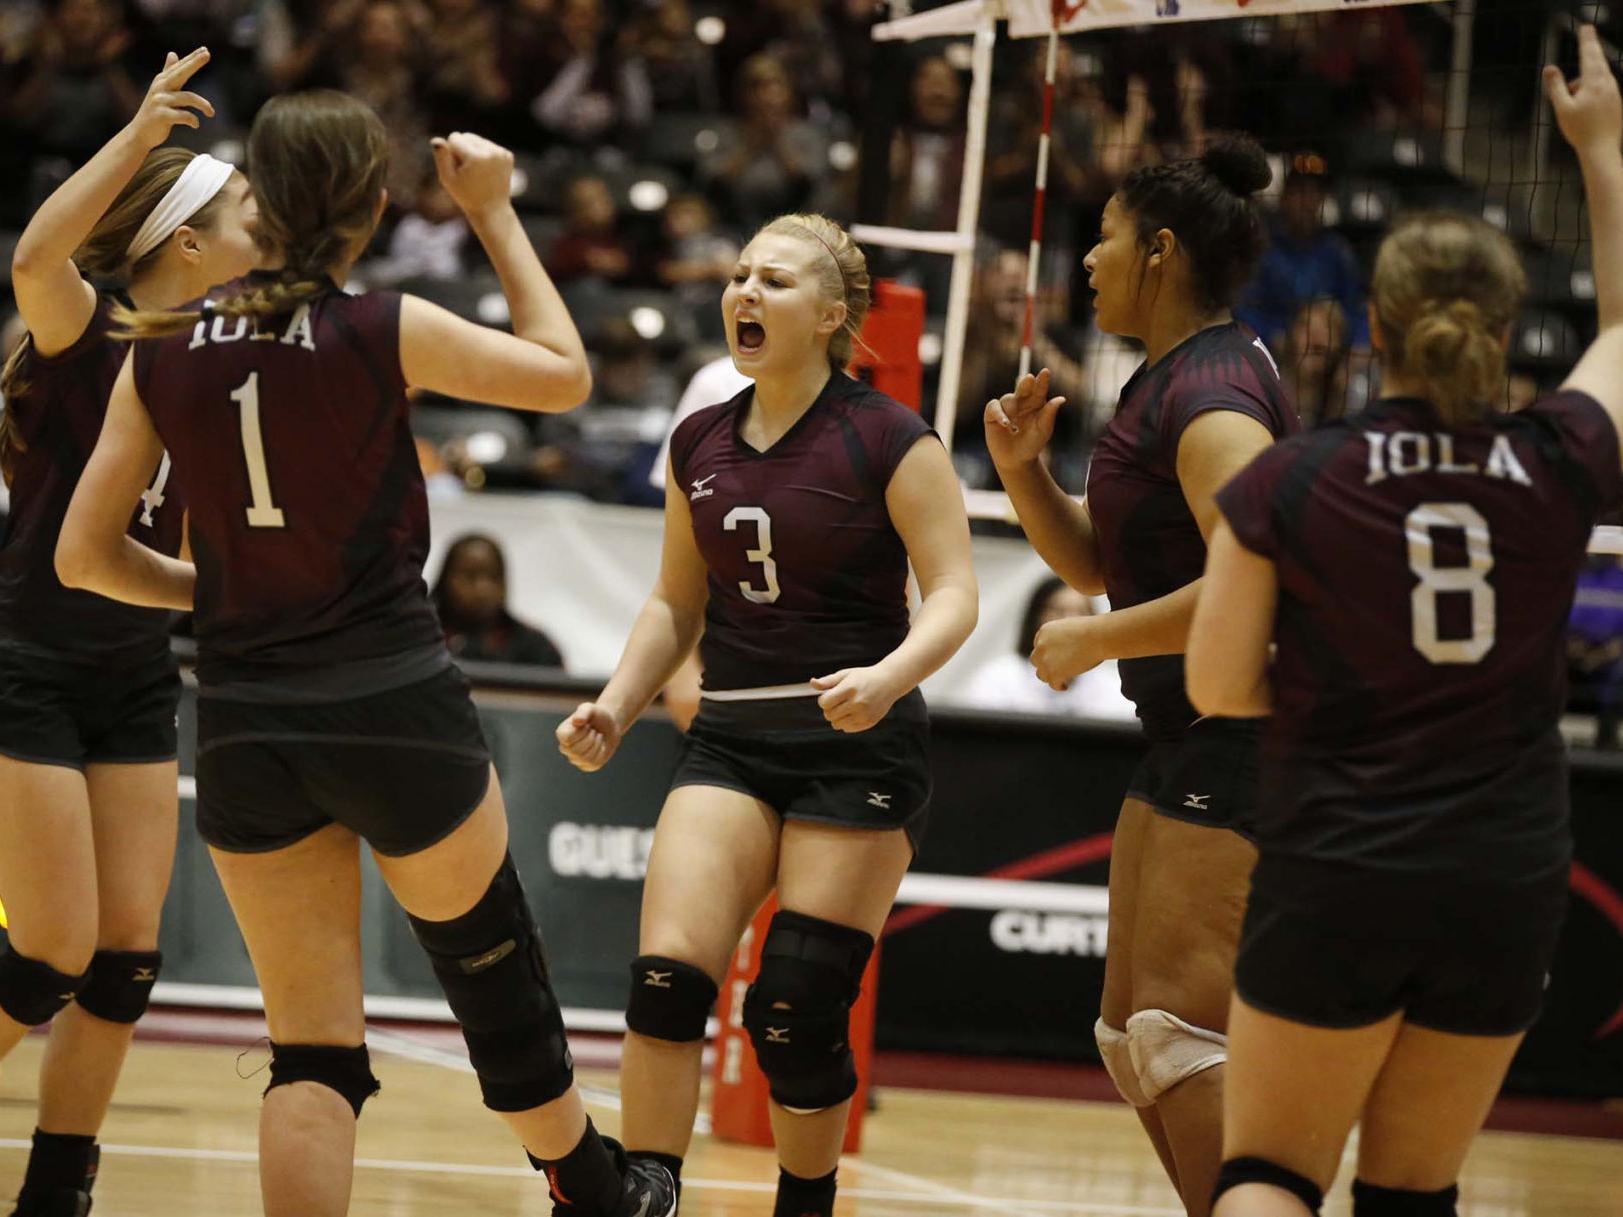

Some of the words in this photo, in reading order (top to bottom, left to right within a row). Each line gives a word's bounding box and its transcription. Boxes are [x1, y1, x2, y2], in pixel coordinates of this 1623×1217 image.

[230, 372, 286, 528] 1
[1364, 431, 1533, 487] IOLA
[723, 507, 780, 604] 3
[1405, 503, 1496, 664] 8
